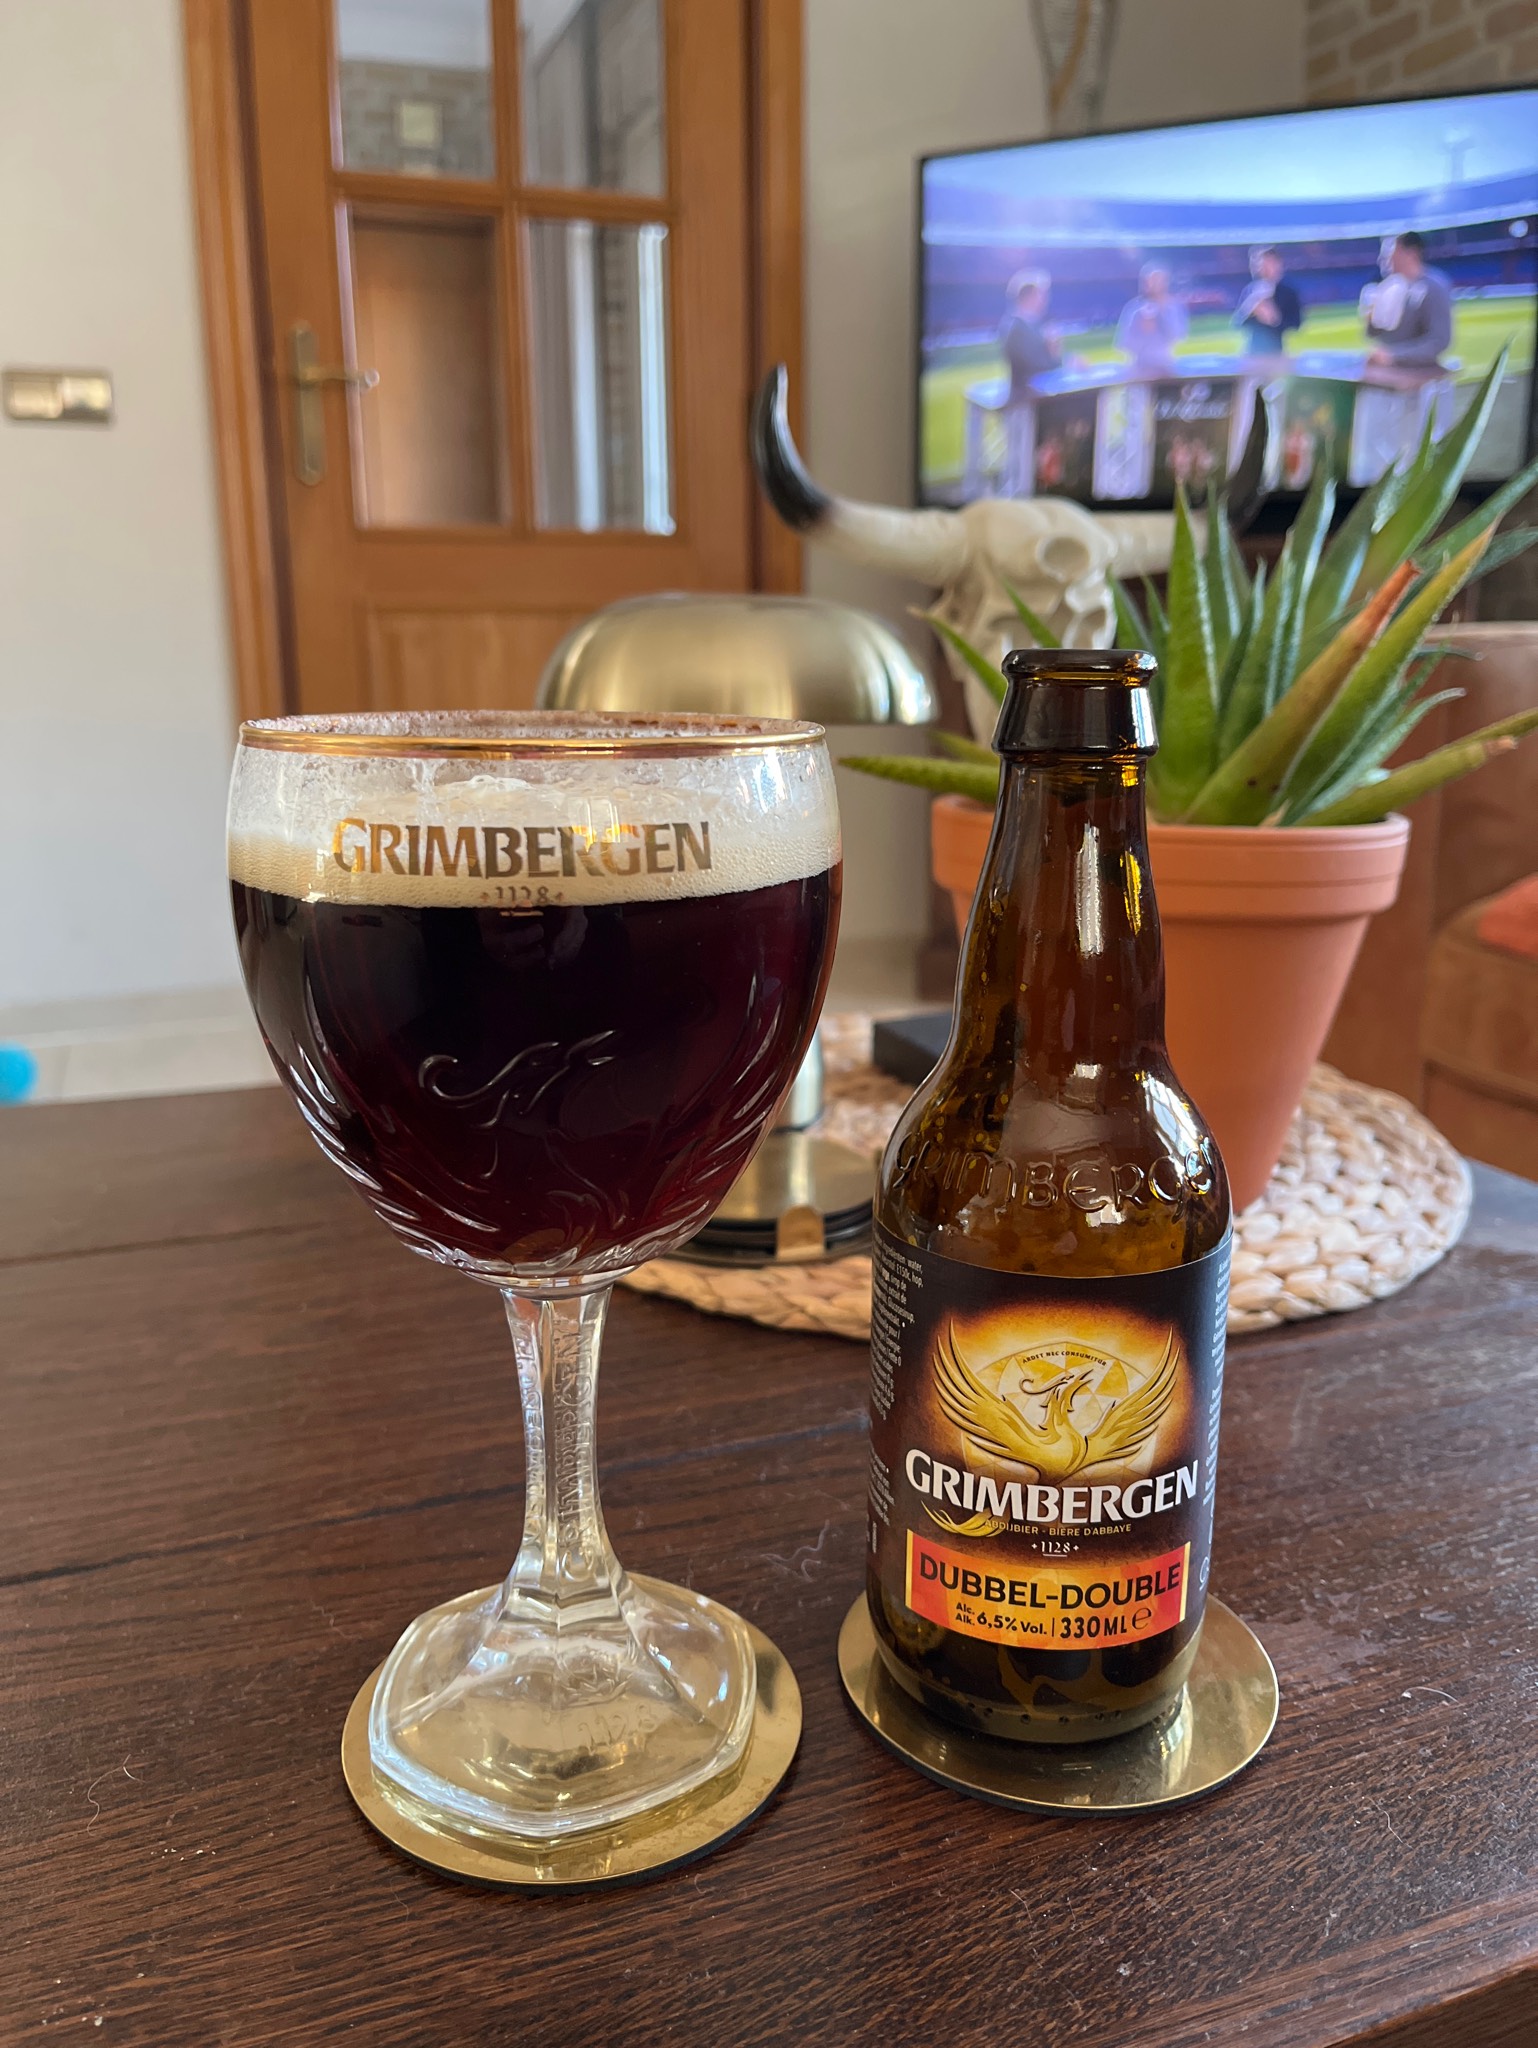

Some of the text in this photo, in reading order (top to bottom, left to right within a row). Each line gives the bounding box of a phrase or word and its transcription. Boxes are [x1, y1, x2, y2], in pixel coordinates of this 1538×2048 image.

[331, 817, 712, 879] GRIMBERGEN
[1022, 1353, 1044, 1364] ARDET
[905, 1448, 1199, 1524] GRIMBERGEN
[984, 1519, 1039, 1535] ABDIJBIER
[1083, 1523, 1132, 1537] D'ABBAYE
[1041, 1541, 1071, 1553] 1128
[919, 1551, 1181, 1610] DUBBEL-DOUBLE
[955, 1601, 976, 1616] Alc.
[955, 1612, 976, 1627] Alk.
[976, 1613, 1018, 1633] 6,5%
[1020, 1621, 1048, 1636] Vol.
